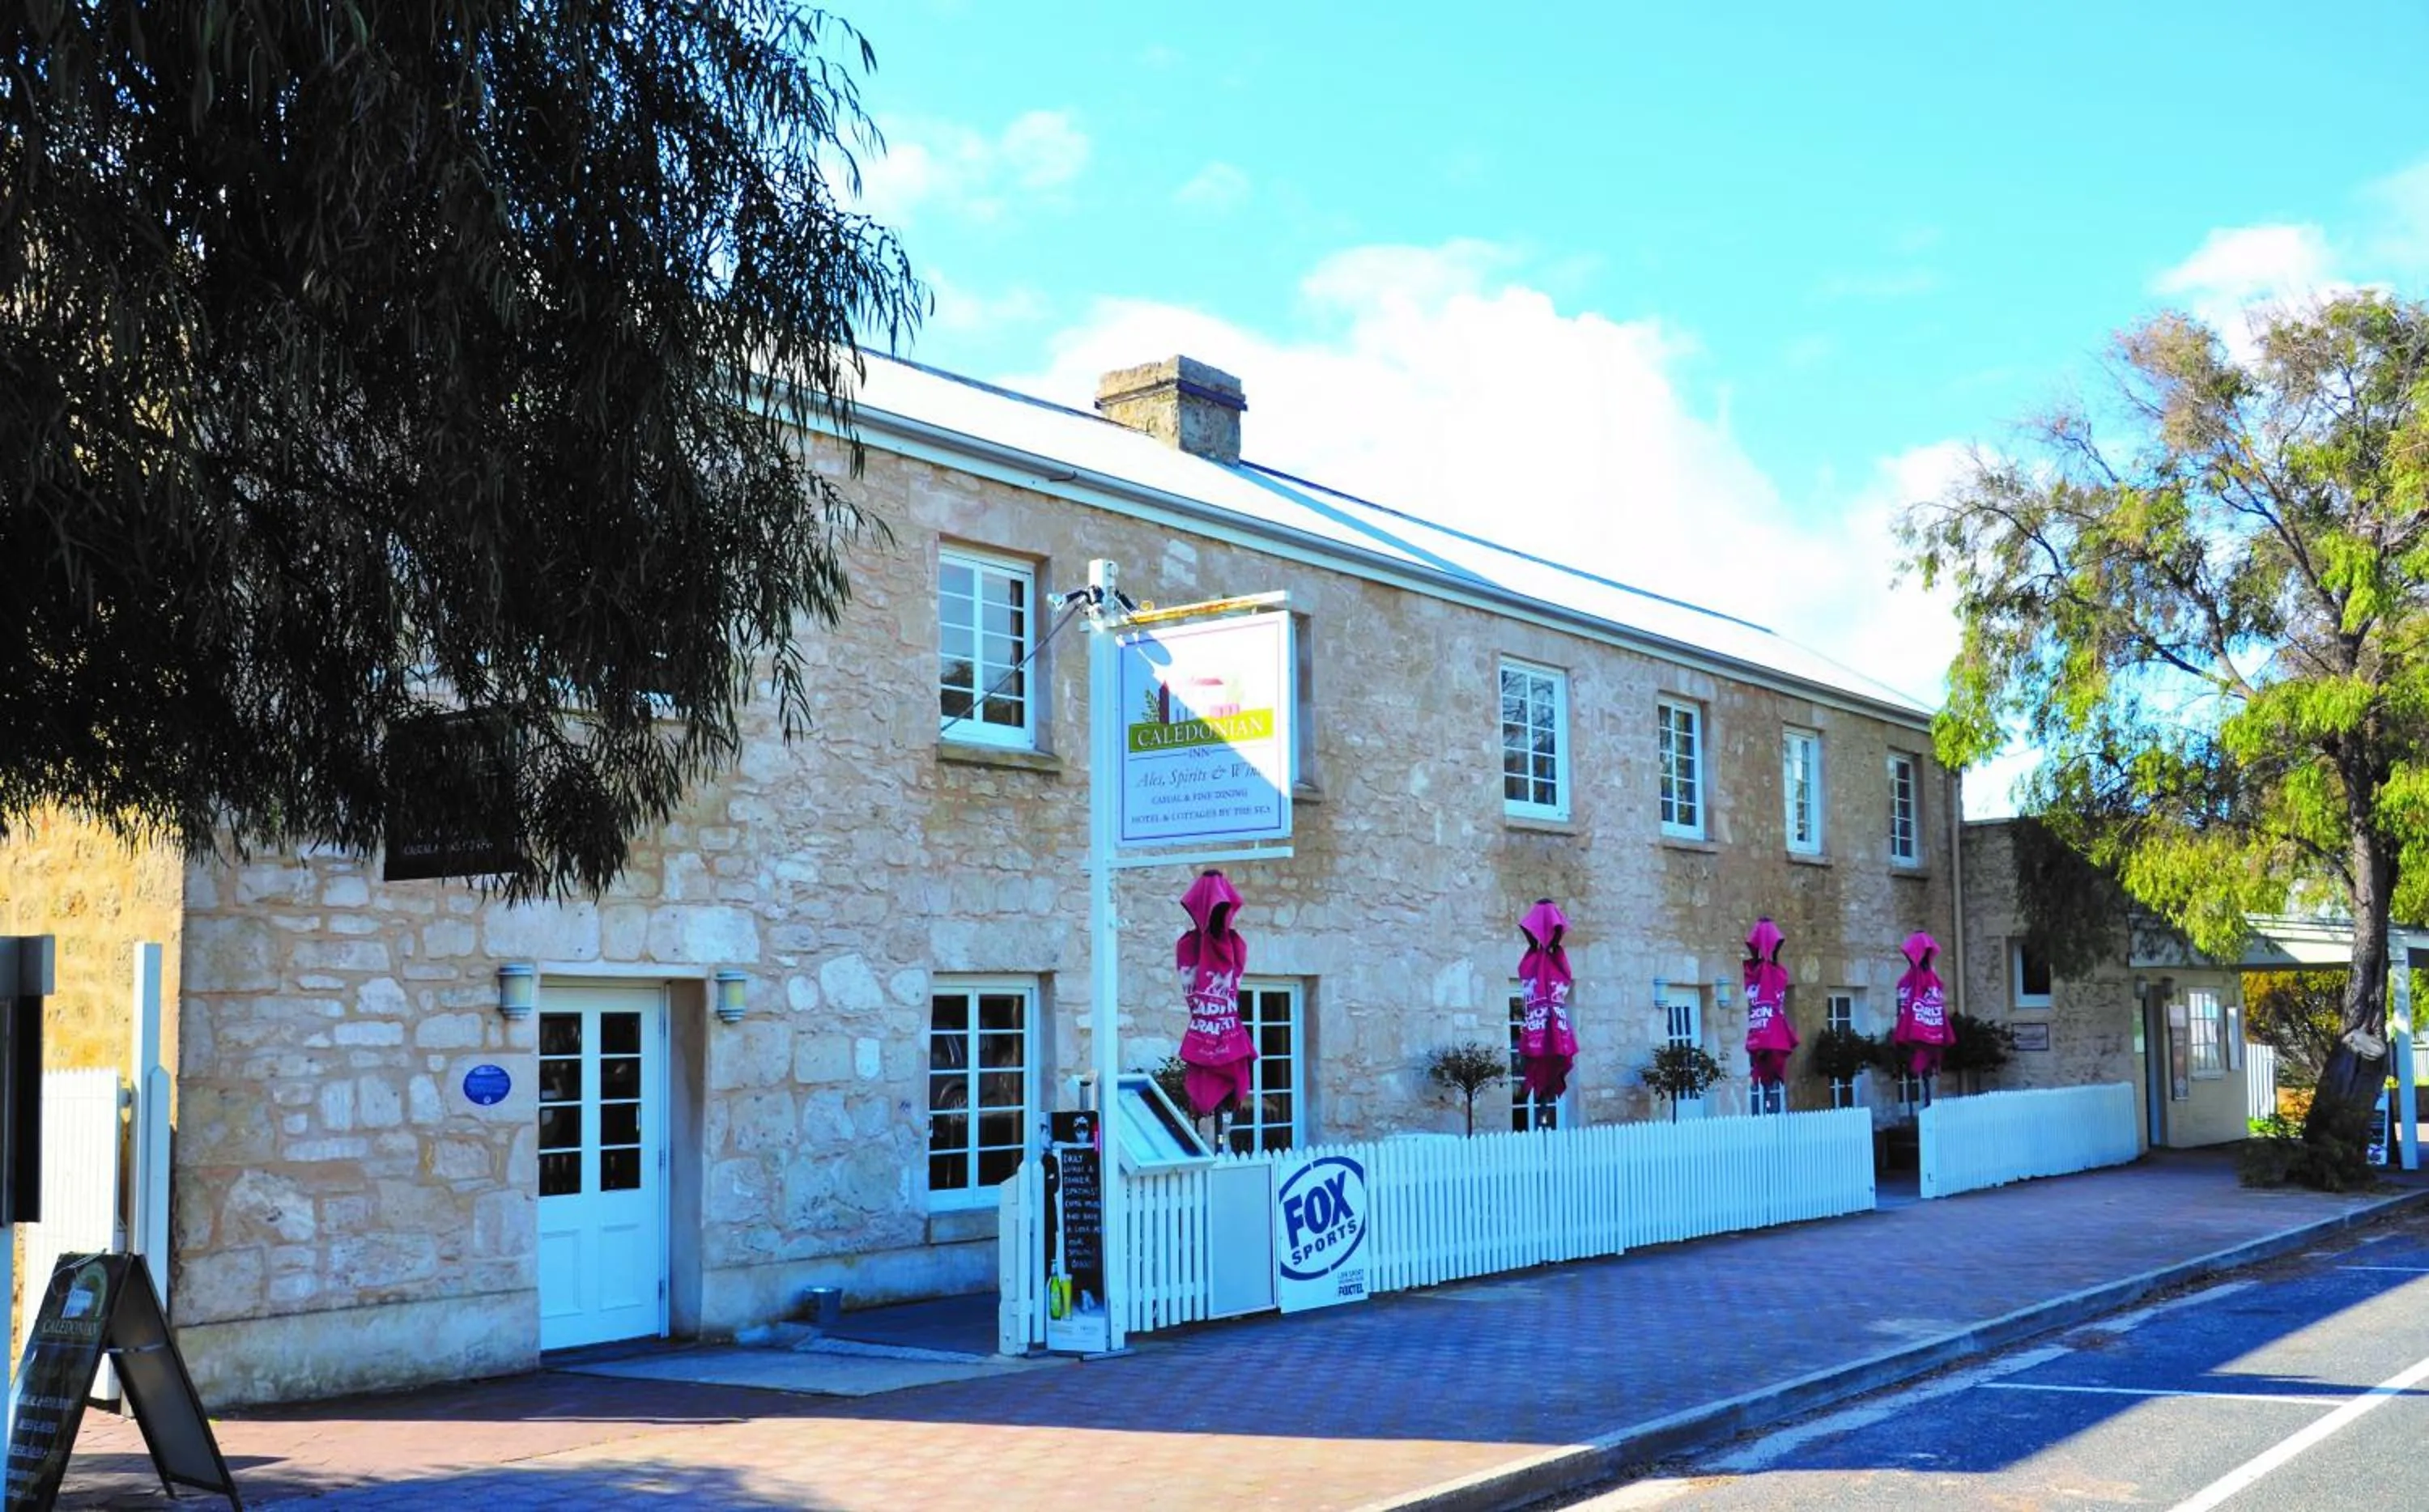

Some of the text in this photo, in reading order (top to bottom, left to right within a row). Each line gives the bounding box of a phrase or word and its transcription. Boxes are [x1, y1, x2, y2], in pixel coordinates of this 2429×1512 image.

[1137, 715, 1264, 746] CALEDONIAN
[1189, 747, 1210, 758] INN
[1170, 767, 1206, 788] Spirits
[1211, 765, 1226, 780] &
[1214, 788, 1249, 799] DINING
[1131, 814, 1159, 824] HOTEL
[1219, 808, 1231, 817] BY
[1234, 807, 1250, 816] THE
[1283, 1170, 1355, 1250] FOX
[1291, 1220, 1358, 1266] SPORTS
[1338, 1283, 1364, 1296] FOXTEL
